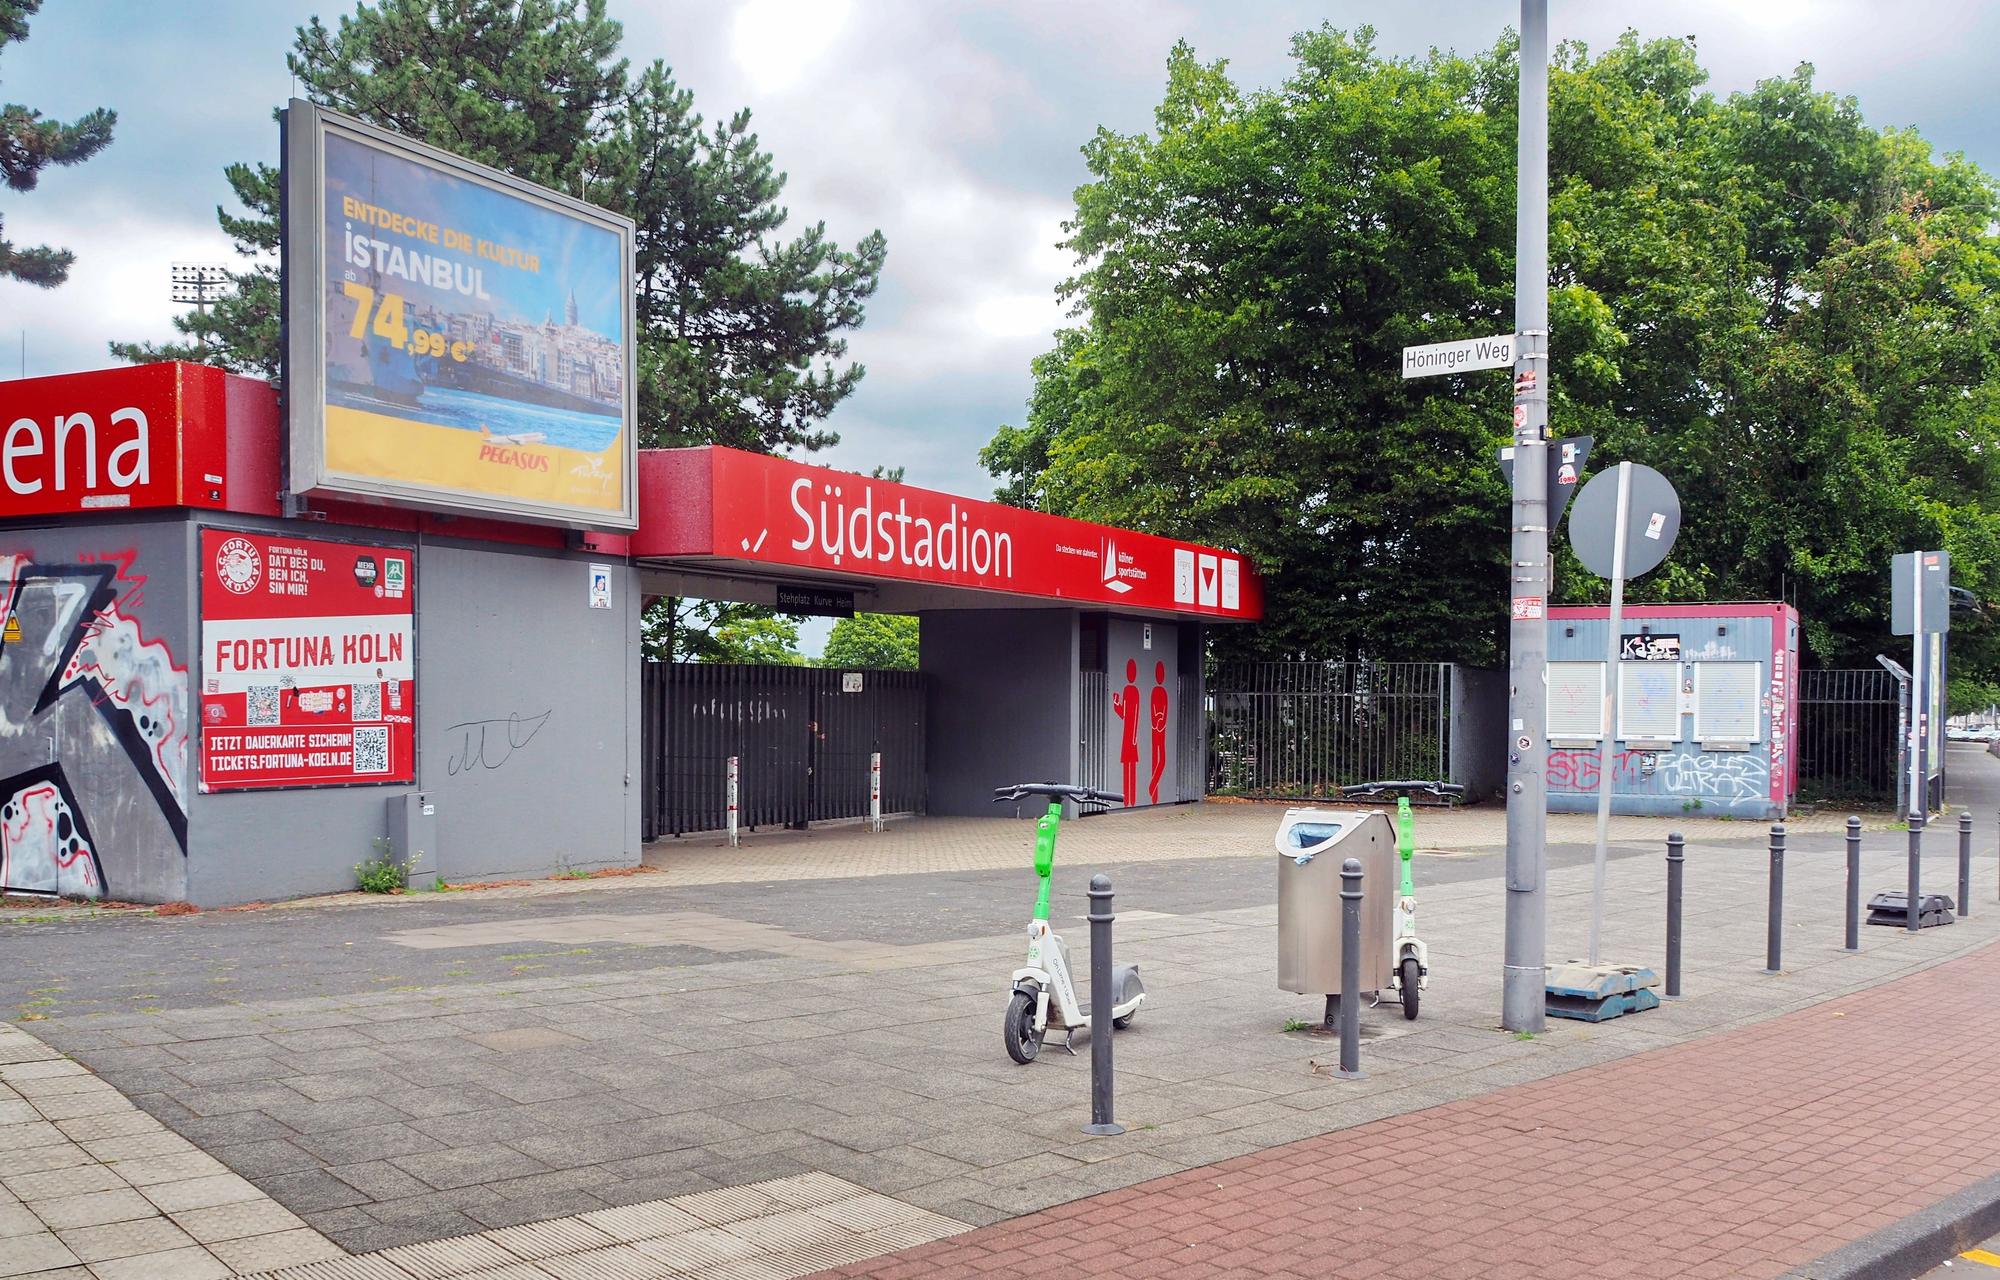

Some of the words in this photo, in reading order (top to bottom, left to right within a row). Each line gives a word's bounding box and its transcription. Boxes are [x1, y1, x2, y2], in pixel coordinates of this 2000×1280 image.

[343, 196, 439, 244] ENTDECKE
[444, 227, 473, 255] DIE
[477, 238, 541, 273] KULTUR
[344, 269, 357, 282] ab
[343, 281, 446, 358] 74,99
[1406, 348, 1471, 369] Höninger
[1475, 341, 1510, 362] Weg
[479, 444, 550, 473] PEGASUS
[790, 477, 1013, 579] Südstadion
[222, 539, 261, 577] FORTUNA
[268, 545, 293, 556] FORTUNA
[1118, 551, 1134, 564] kölner
[268, 554, 287, 569] DAT
[289, 556, 308, 571] BES
[268, 568, 288, 582] BEN
[1117, 567, 1147, 580] sportstätten
[268, 581, 285, 595] SIN
[287, 583, 308, 597] MIR!
[1182, 575, 1188, 596] 3
[779, 592, 810, 606] Stehplatz
[814, 595, 833, 607] Kurve
[836, 597, 853, 608] Heim
[216, 635, 334, 673] FORTUNA
[211, 736, 242, 751] JETZT
[245, 735, 305, 750] DAUERKARTE
[308, 733, 352, 748] SICHERN!
[210, 751, 352, 772] TICKETS.FORTUNA-KOELN.DE
[1655, 753, 1767, 777] EAGLES
[1664, 769, 1762, 807] ULTRAS
